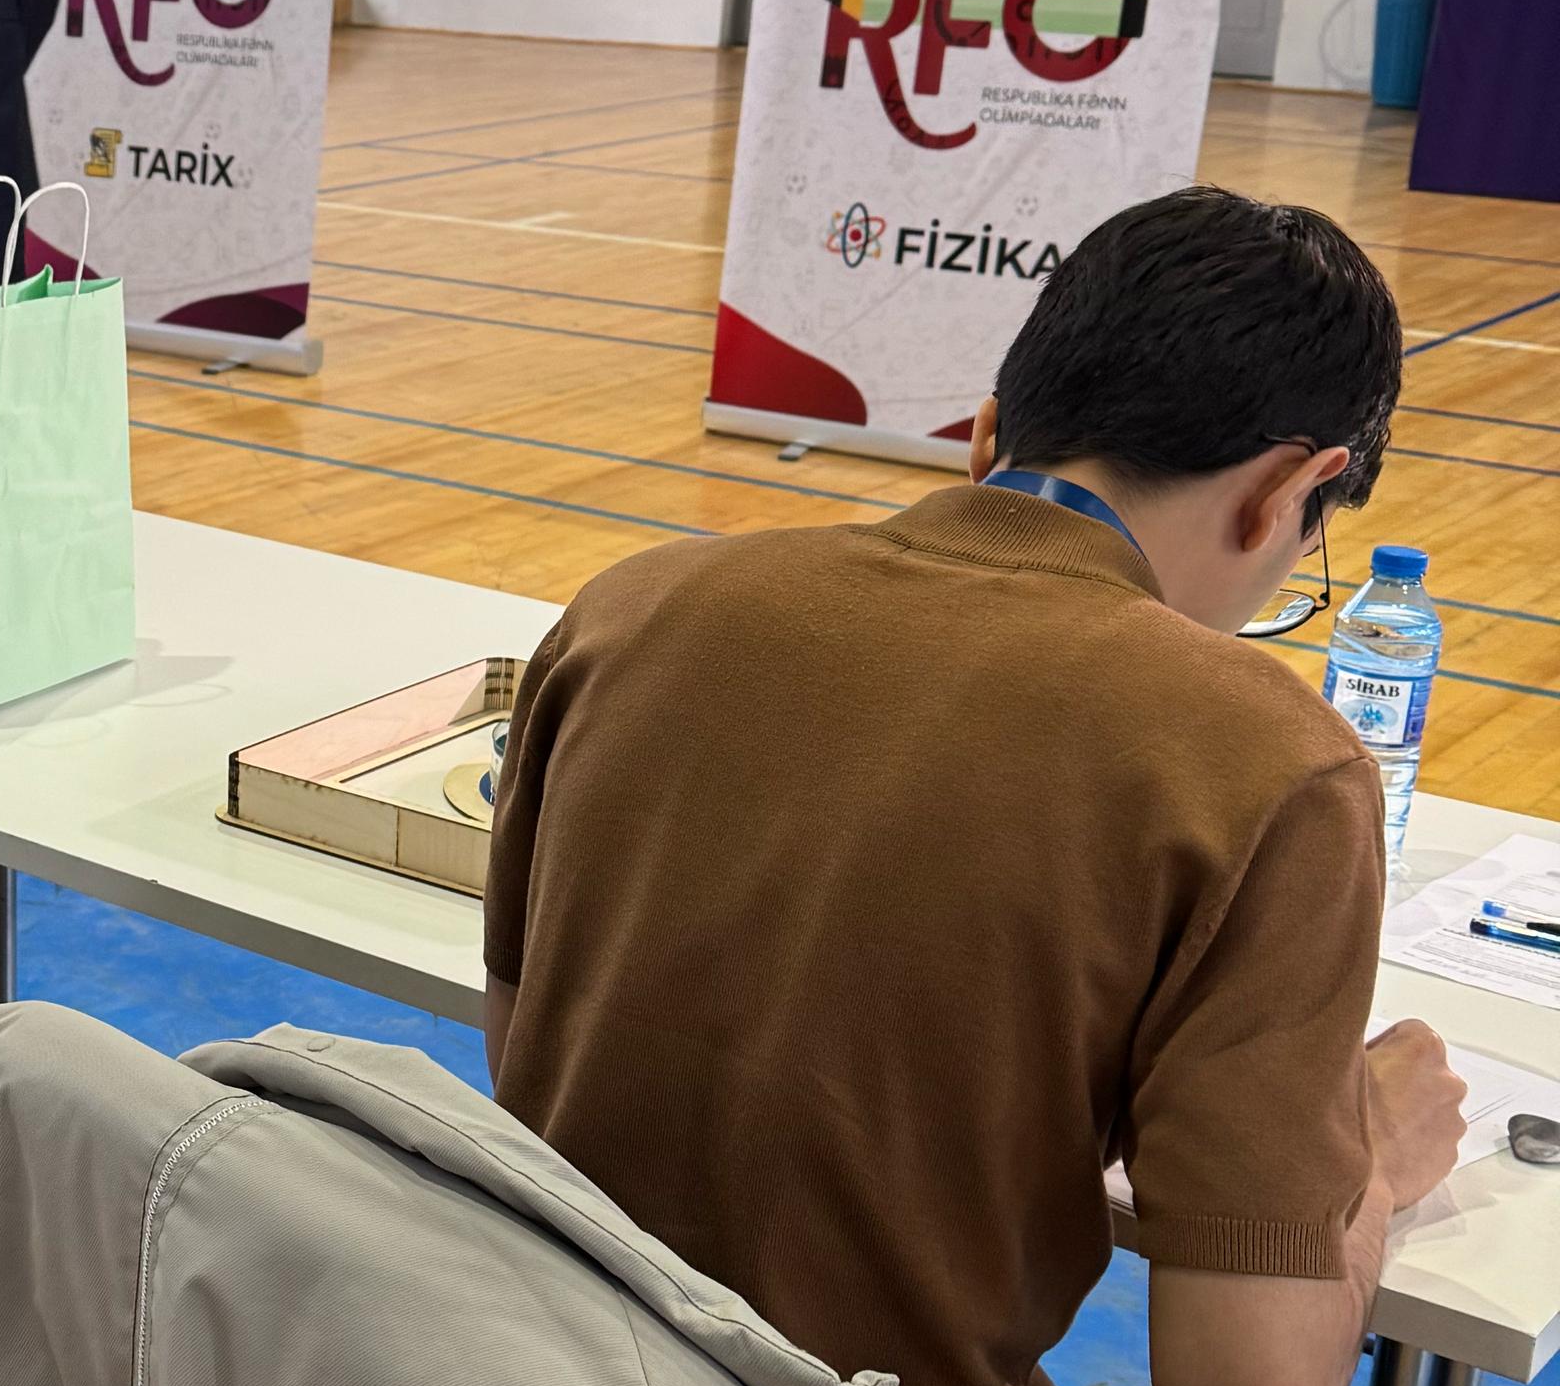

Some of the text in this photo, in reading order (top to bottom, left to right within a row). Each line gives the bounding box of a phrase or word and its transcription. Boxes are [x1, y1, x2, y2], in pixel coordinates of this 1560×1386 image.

[981, 86, 1127, 110] RESPUBLİKA FƏNN
[979, 106, 1101, 129] OLİMPİADALARI
[128, 142, 235, 188] TARİX
[894, 218, 1064, 280] FİZİKA
